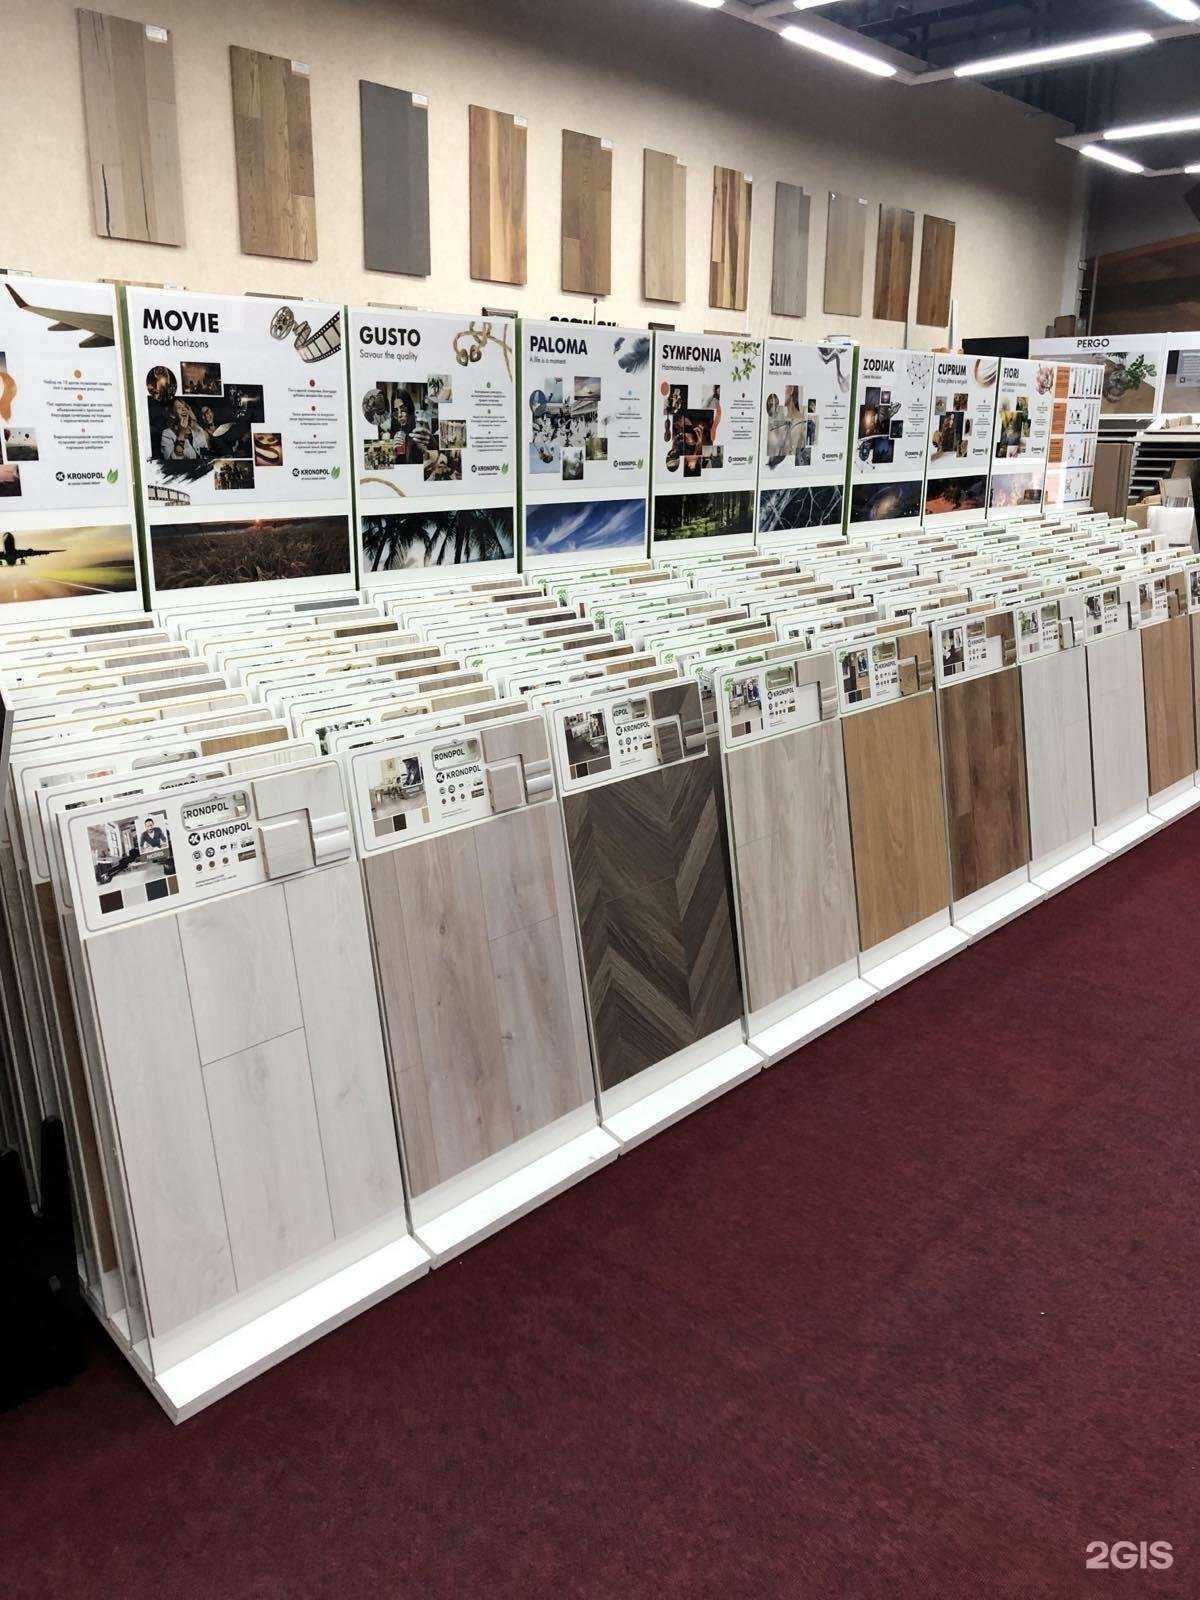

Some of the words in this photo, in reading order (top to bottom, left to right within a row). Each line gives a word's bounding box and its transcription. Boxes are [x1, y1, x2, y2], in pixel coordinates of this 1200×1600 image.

[143, 308, 219, 333] MOVIE
[144, 335, 170, 346] Broad
[172, 336, 209, 348] horizons
[359, 326, 421, 347] GUSTO
[1077, 338, 1110, 348] PERGO
[530, 335, 588, 355] PALOMA
[360, 349, 383, 359] Savour
[385, 350, 395, 359] the
[397, 351, 417, 362] quality
[662, 344, 722, 363] SYMFONIA
[769, 352, 792, 367] SLIM
[863, 358, 895, 372] ZODIAK
[938, 363, 967, 376] CUPRUM
[1003, 367, 1020, 379] FIORI
[66, 471, 105, 480] KRONOPOL
[300, 467, 330, 476] KRONOPOL
[434, 748, 466, 761] RONOPOL
[446, 764, 482, 780] KRONOPOL
[202, 822, 253, 841] KRONOPOL
